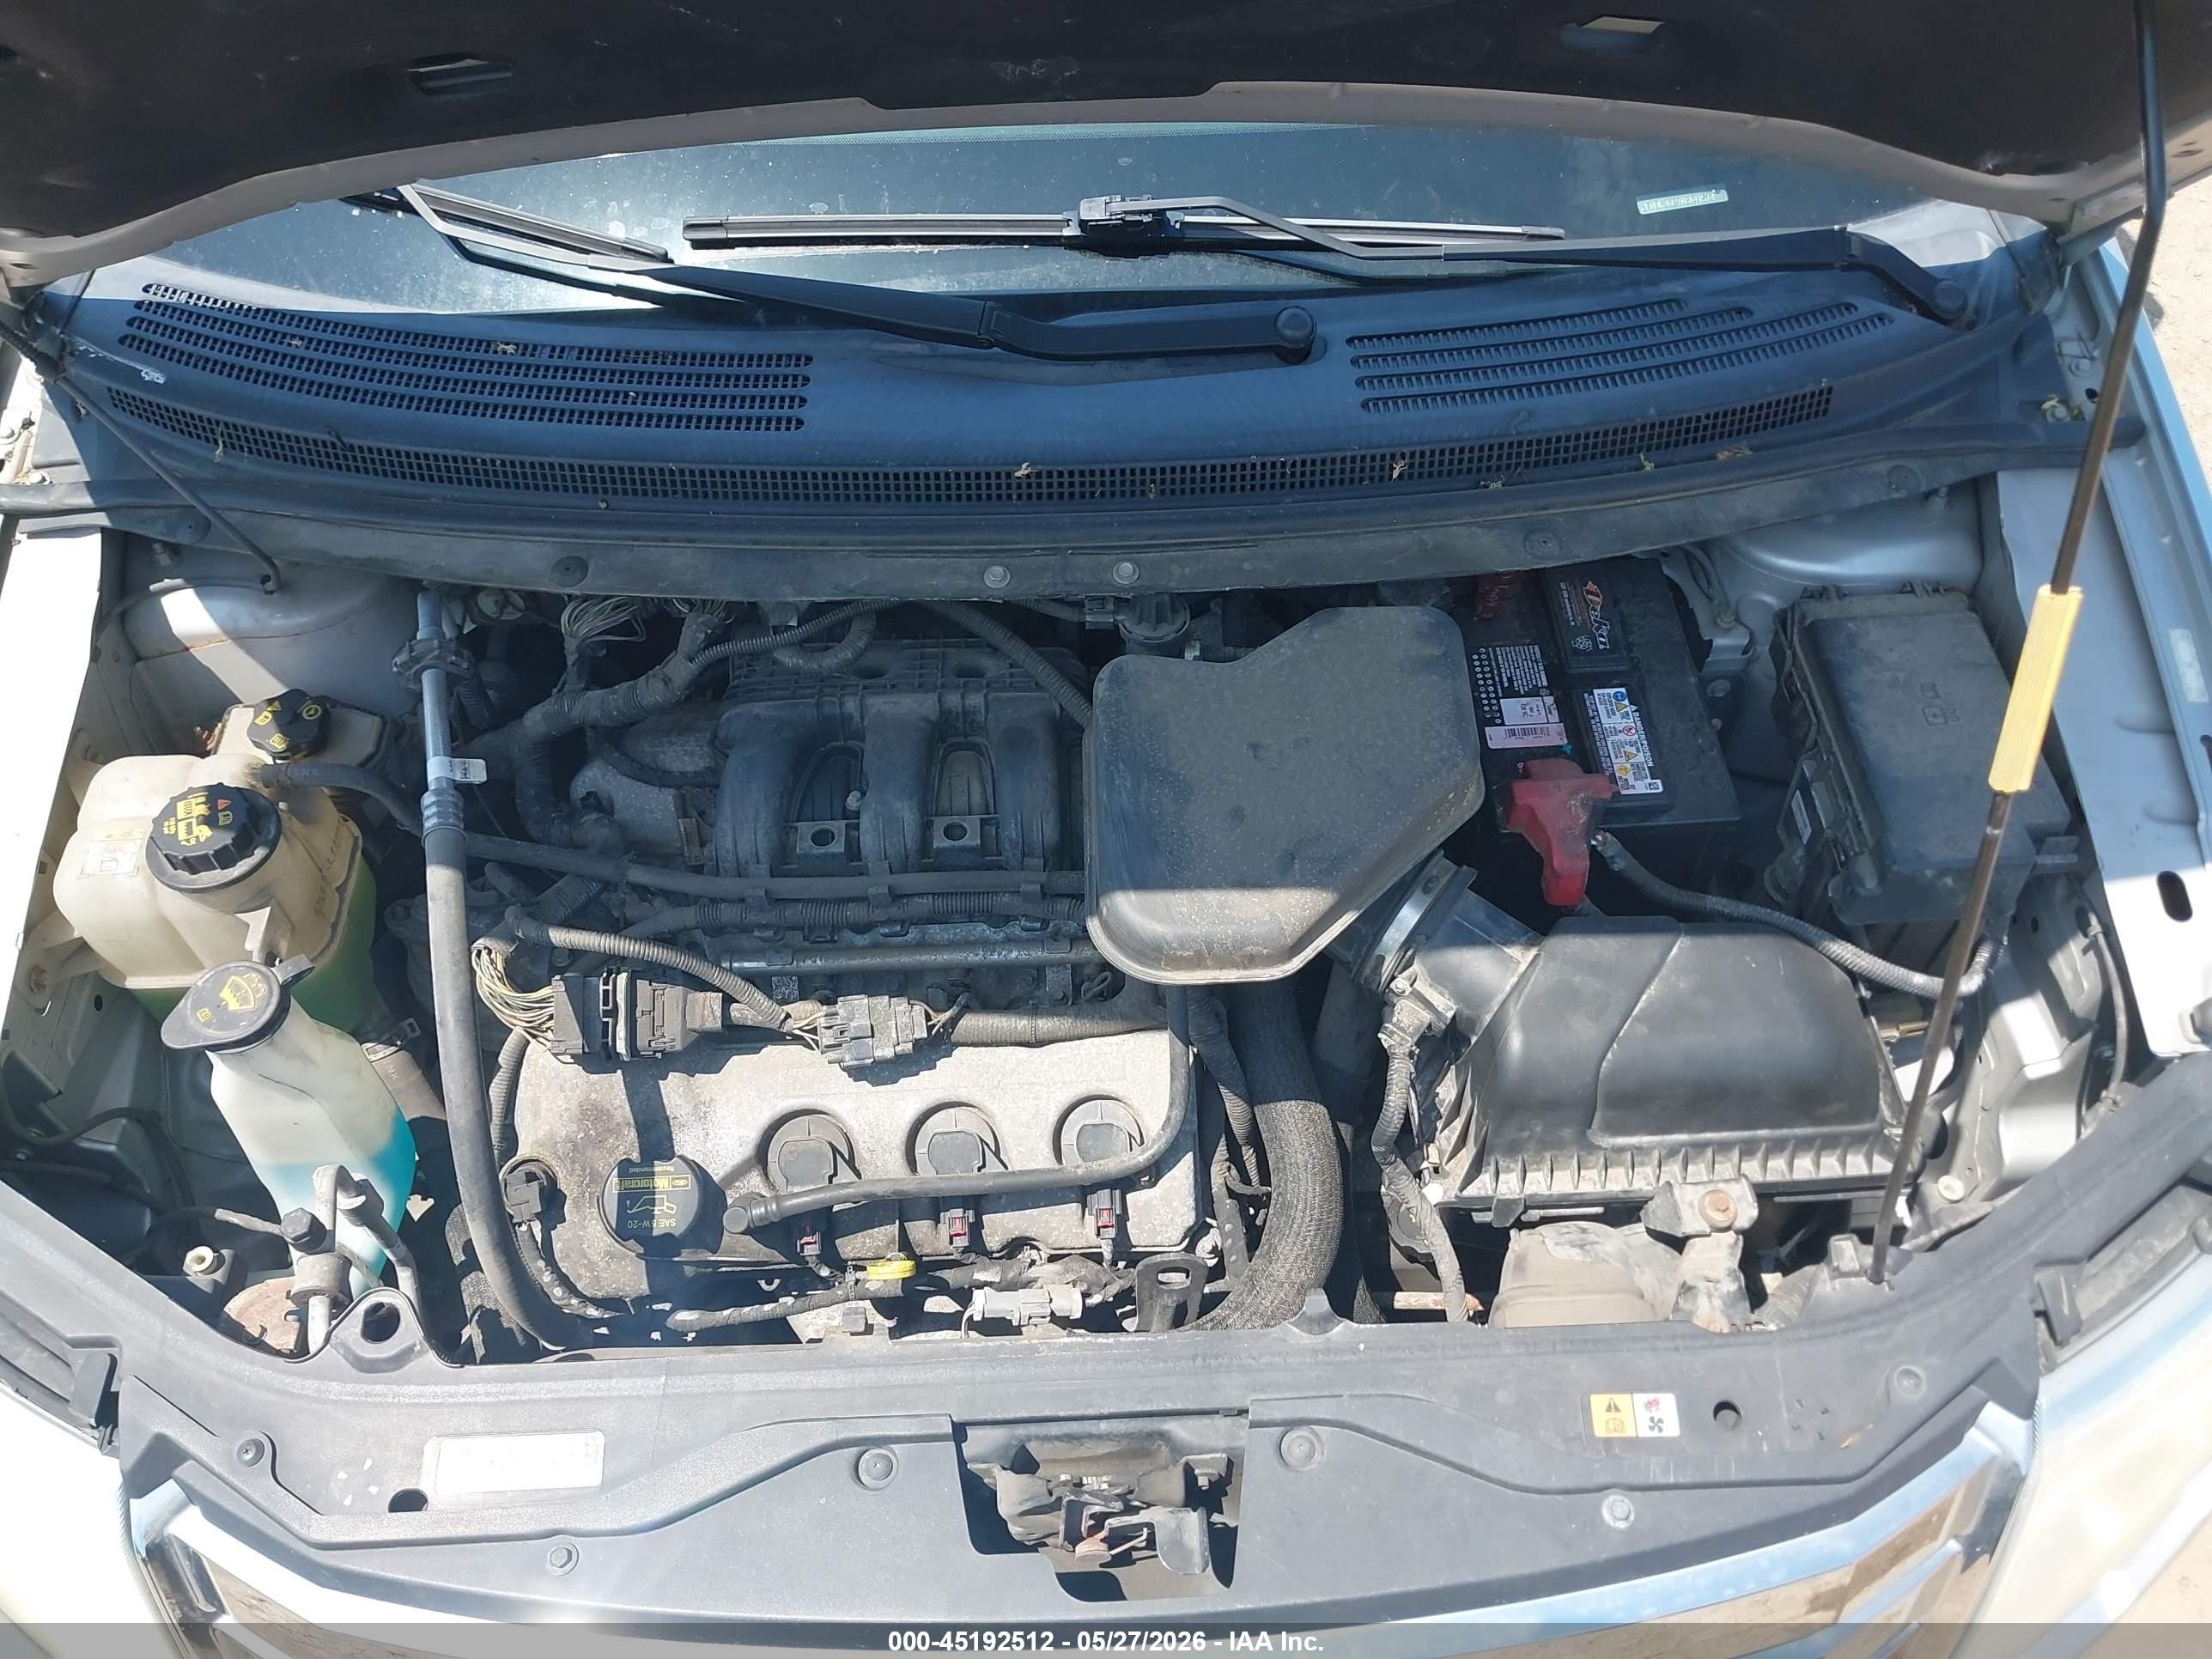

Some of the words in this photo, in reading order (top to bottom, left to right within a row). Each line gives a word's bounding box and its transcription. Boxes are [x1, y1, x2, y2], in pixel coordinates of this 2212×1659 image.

[629, 1165, 675, 1175] Recommended
[614, 1176, 669, 1191] Motorcraft
[657, 1218, 677, 1228] SAE
